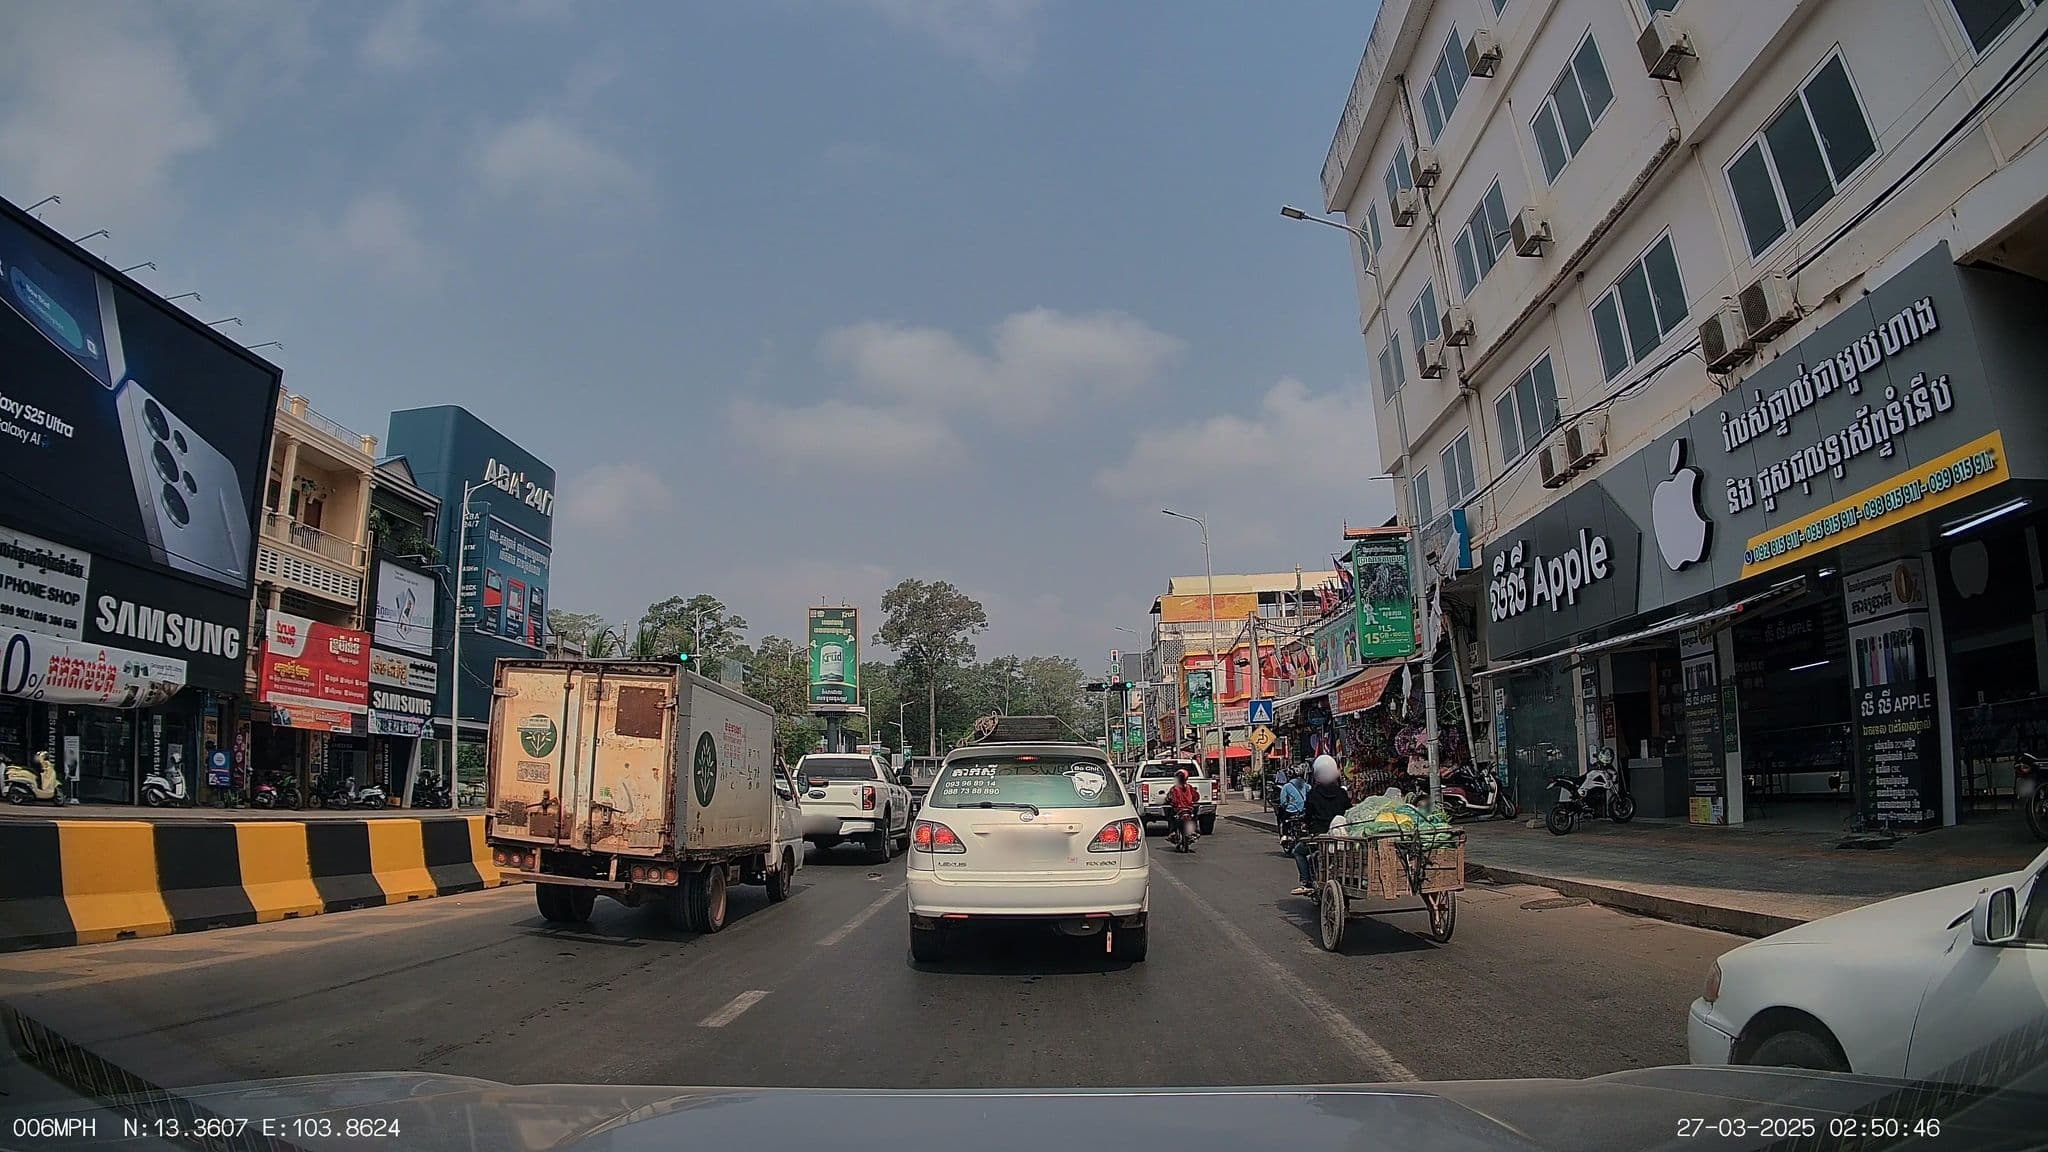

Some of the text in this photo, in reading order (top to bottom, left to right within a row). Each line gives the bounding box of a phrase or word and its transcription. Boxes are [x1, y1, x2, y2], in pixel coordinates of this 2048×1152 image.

[0, 392, 74, 438] axy S25 Ultra
[0, 418, 41, 446] alaxy AI
[1726, 478, 1753, 514] និង
[1754, 543, 1770, 562] 092
[1770, 538, 1786, 555] 815
[1805, 521, 1823, 542] 093
[1824, 514, 1841, 535] 815
[1862, 497, 1884, 520] 098
[1884, 488, 1903, 511] 815
[1928, 469, 1951, 494] 099
[1952, 458, 1973, 483] 815
[1532, 528, 1608, 612] Apple
[5, 576, 81, 606] PHONE SHOP
[96, 595, 240, 660] SAMSUNG
[276, 620, 296, 636] true
[1364, 632, 1380, 645] 15
[373, 690, 431, 716] SAMSUNG
[1699, 693, 1718, 704] APPLE
[1861, 689, 1932, 717] លី លី APPLE
[49, 719, 57, 766] SAMSU
[153, 732, 161, 776] SAMSU
